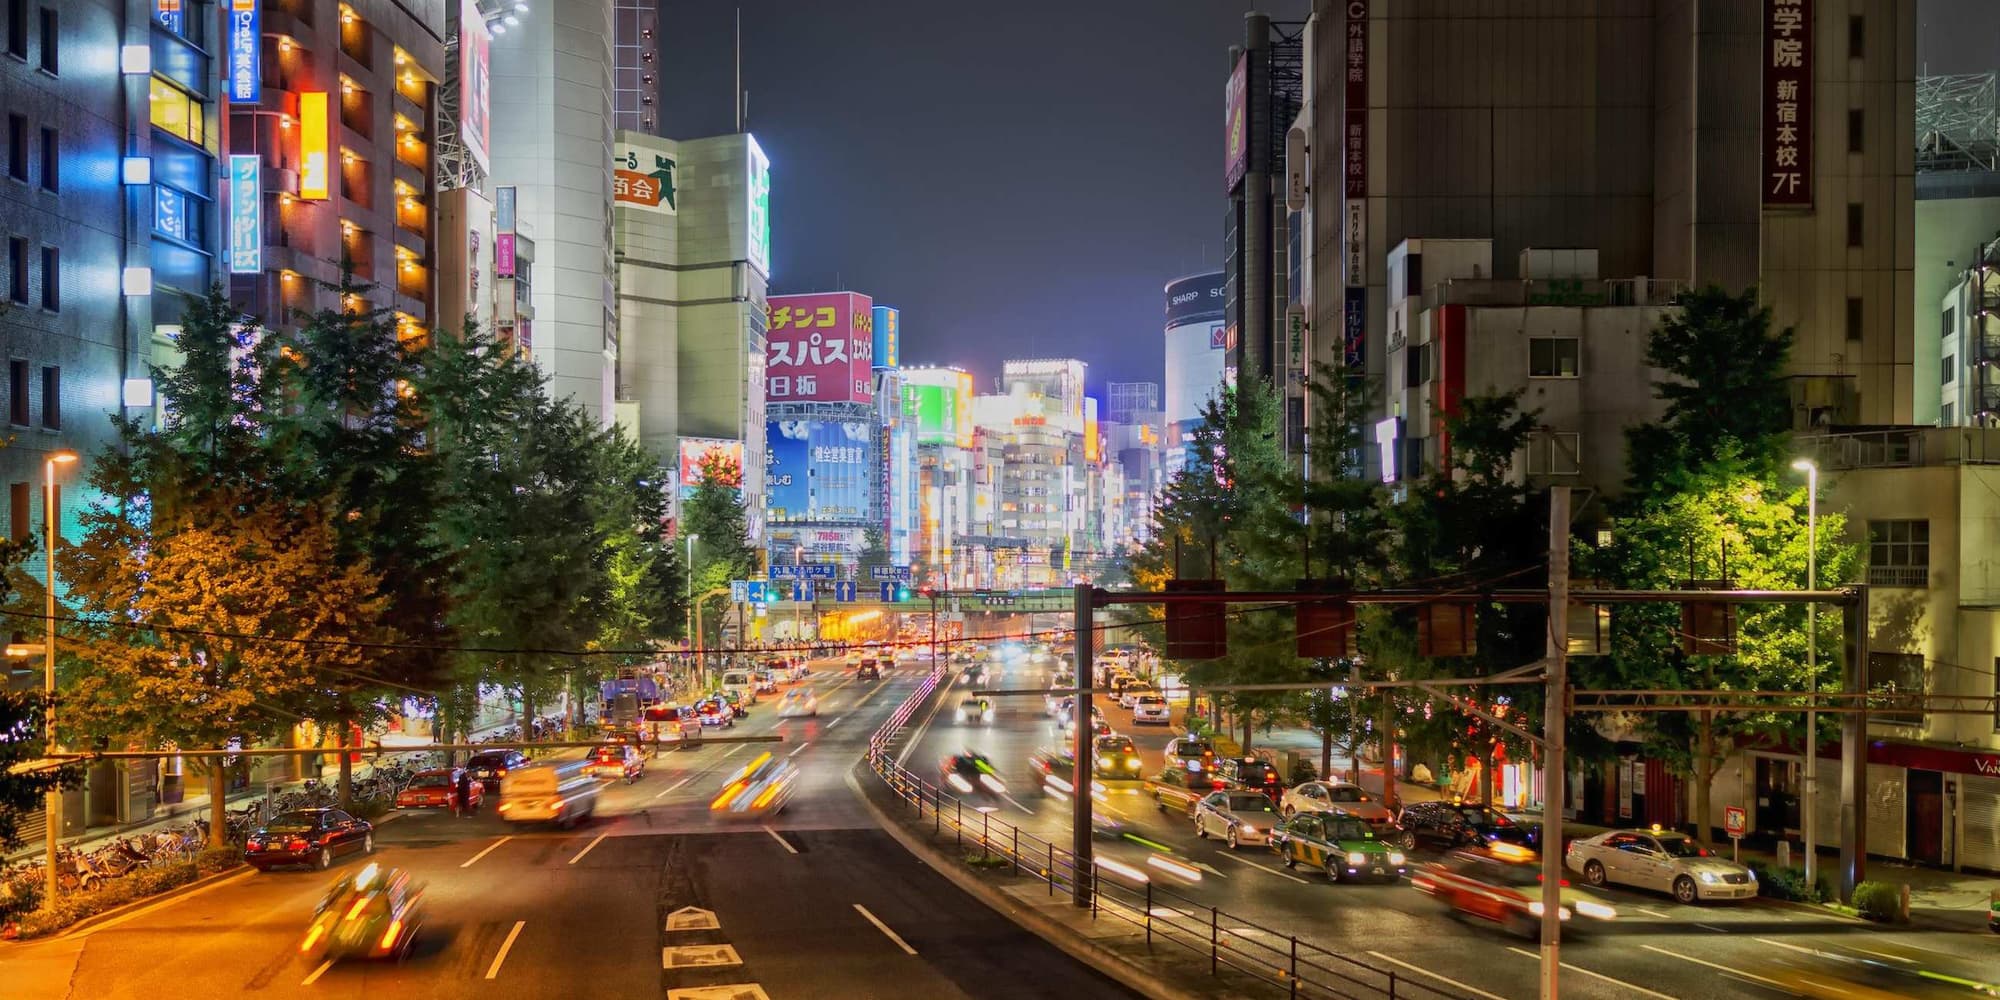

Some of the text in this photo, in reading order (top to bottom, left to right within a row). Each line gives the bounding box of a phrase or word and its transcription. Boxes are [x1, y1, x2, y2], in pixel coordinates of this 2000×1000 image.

[1349, 123, 1363, 175] 新宿本校
[1772, 79, 1801, 195] 新宿本校 7F
[1173, 290, 1199, 305] SHARP
[1349, 299, 1361, 365] エルセーヌ
